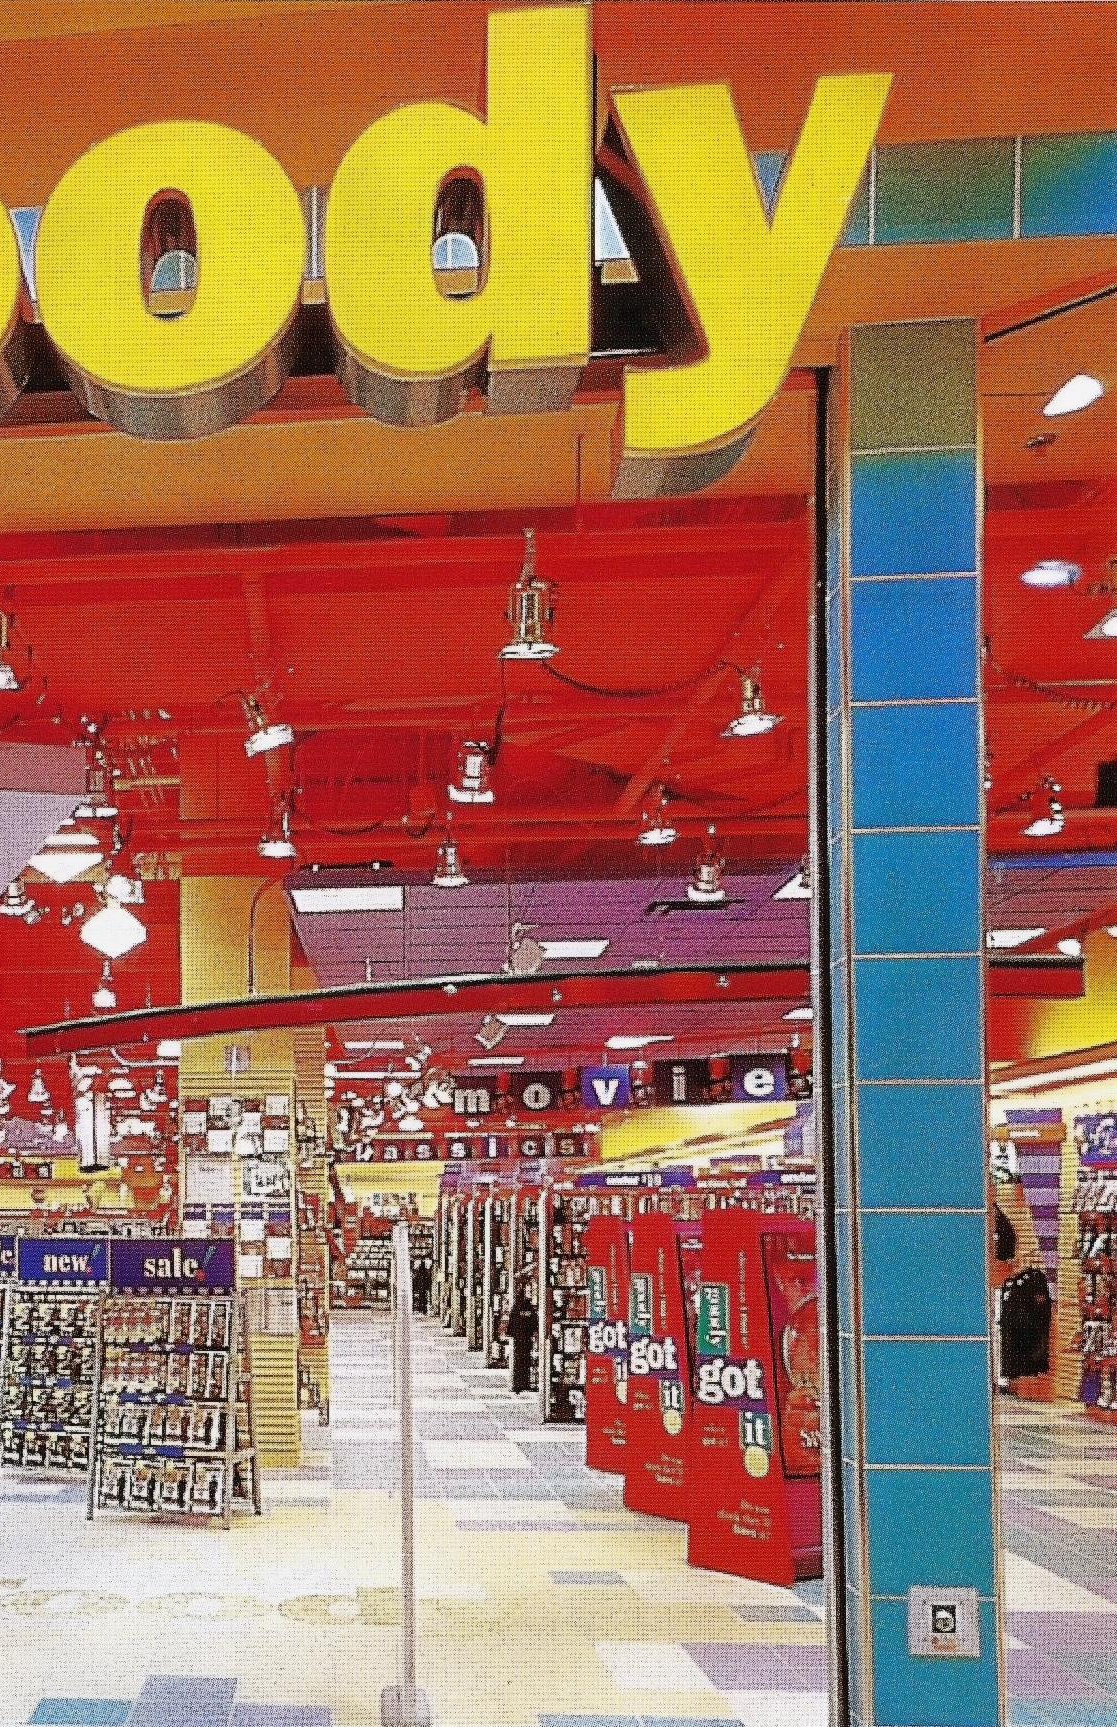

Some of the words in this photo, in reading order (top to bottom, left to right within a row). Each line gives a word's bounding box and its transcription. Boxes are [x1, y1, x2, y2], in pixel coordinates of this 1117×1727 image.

[455, 1066, 776, 1114] movie
[588, 1320, 628, 1354] got
[629, 1335, 679, 1375] got
[662, 1379, 683, 1410] it
[697, 1357, 763, 1404] got
[743, 1411, 766, 1446] it
